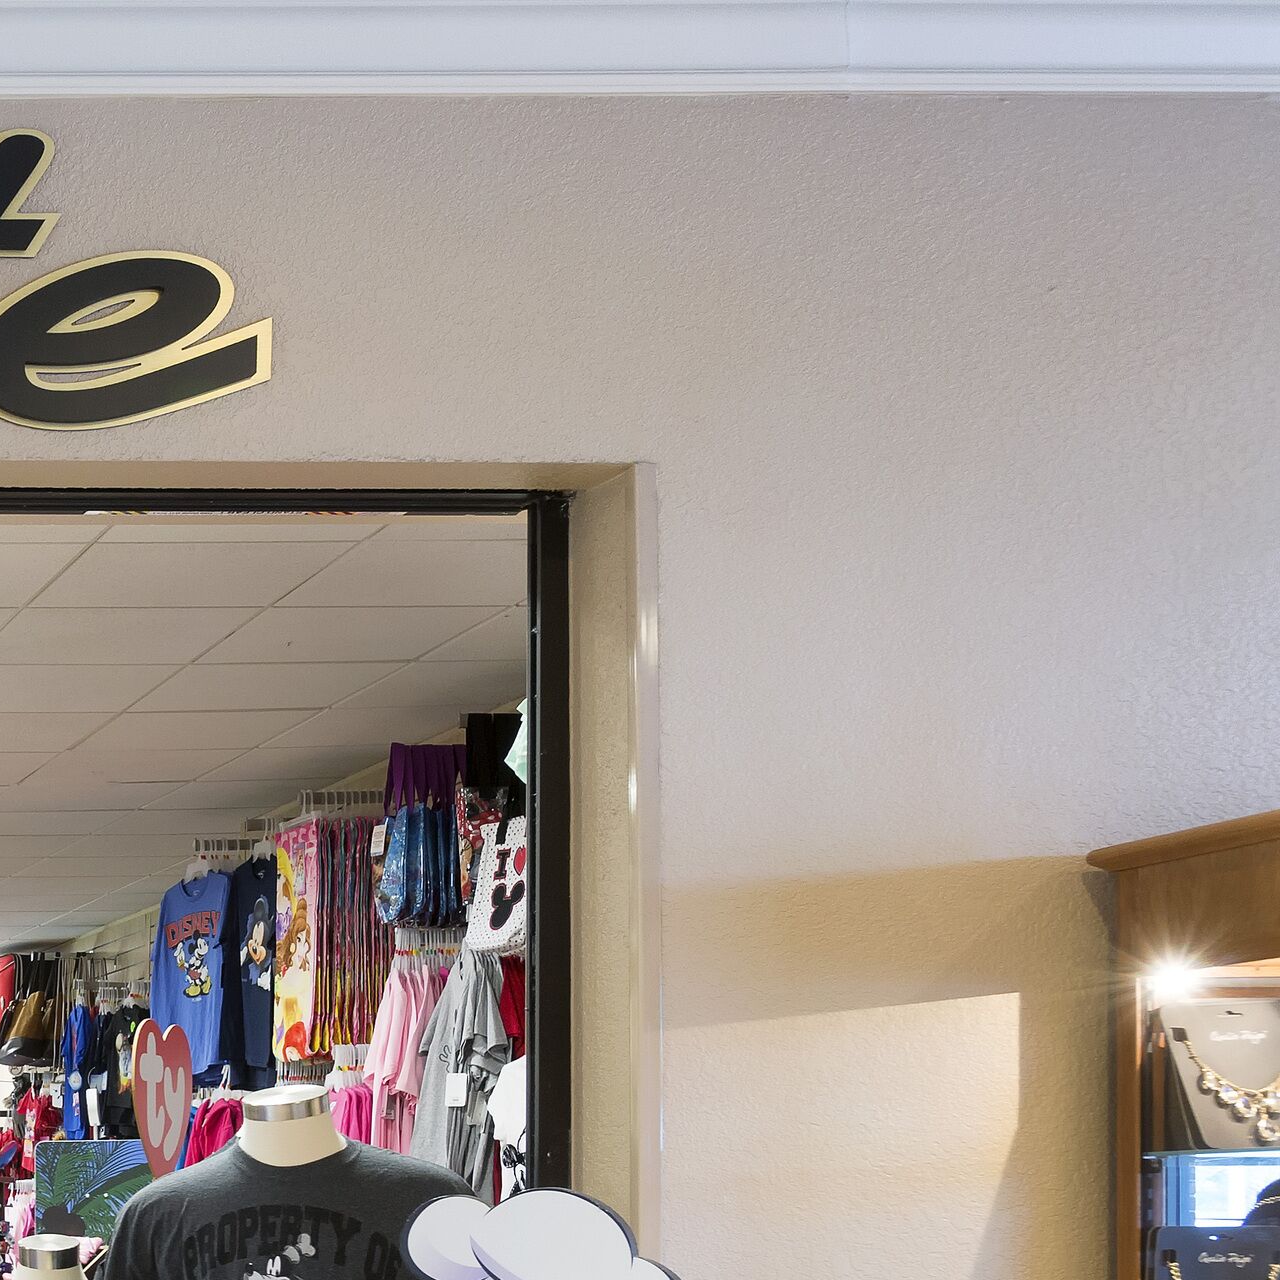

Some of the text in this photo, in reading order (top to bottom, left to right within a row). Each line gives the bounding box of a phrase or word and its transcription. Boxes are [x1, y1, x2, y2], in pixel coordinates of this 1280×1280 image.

[493, 848, 511, 881] I
[165, 911, 221, 949] DISNEY
[138, 1031, 186, 1160] ty
